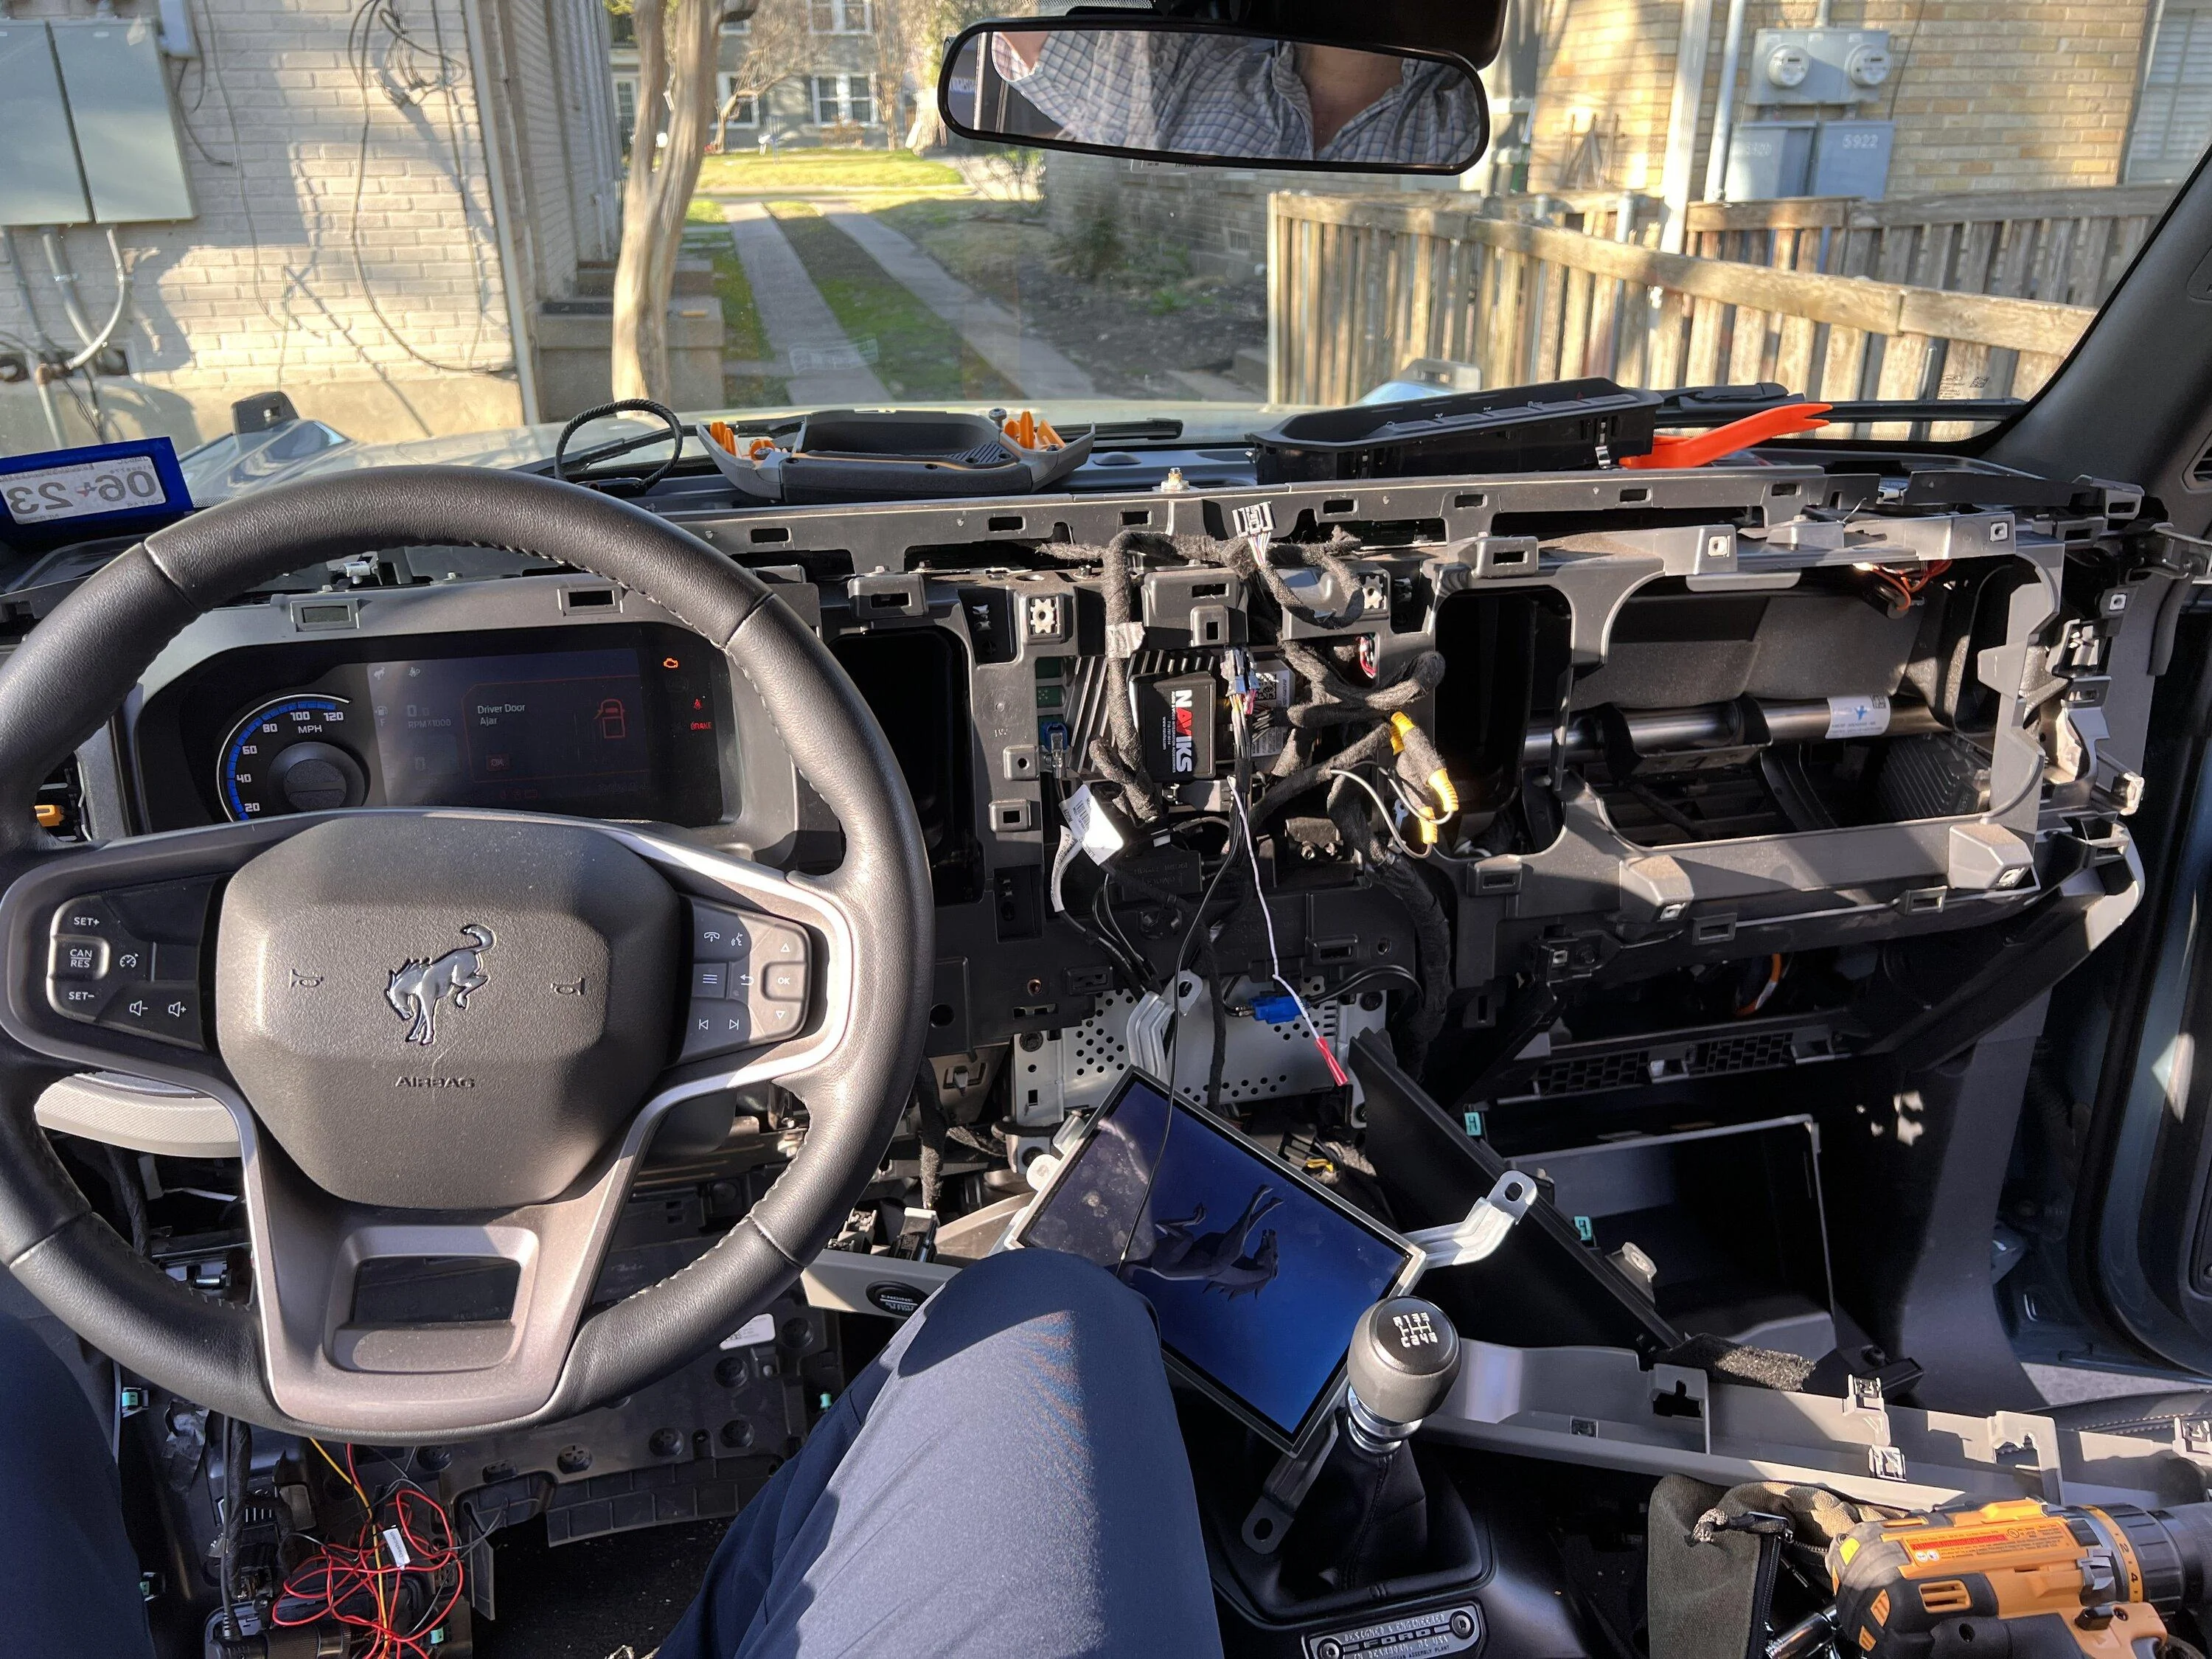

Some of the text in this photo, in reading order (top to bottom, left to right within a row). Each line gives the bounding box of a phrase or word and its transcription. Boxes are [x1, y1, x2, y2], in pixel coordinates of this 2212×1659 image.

[1843, 133, 1879, 147] 5922
[478, 703, 525, 714] Driver Door
[291, 711, 310, 721] 100
[323, 712, 344, 721] 120
[480, 717, 498, 726] Ajar
[690, 722, 712, 730] BRAKE
[262, 723, 278, 733] 80
[298, 725, 322, 734] MPH
[1175, 689, 1192, 773] NAVIKS
[242, 745, 257, 755] 60
[236, 774, 251, 783] 40
[244, 803, 260, 812] 20
[73, 917, 100, 927] SET+
[69, 948, 93, 958] CAN
[70, 960, 90, 968] RES
[777, 977, 790, 985] OK
[394, 1076, 476, 1088] AIRBAG
[880, 1294, 914, 1303] ENGINE
[1419, 1332, 1430, 1344] 4
[2119, 1543, 2129, 1554] 2
[2131, 1572, 2138, 1583] 4
[1344, 1626, 1385, 1642] DESIGNED
[1396, 1613, 1445, 1630] ENGINEERED
[1363, 1627, 1431, 1649] FORD
[1432, 1634, 1449, 1646] USA
[1409, 1649, 1432, 1658] ASSEMBLY
[1435, 1644, 1450, 1652] PLANT
